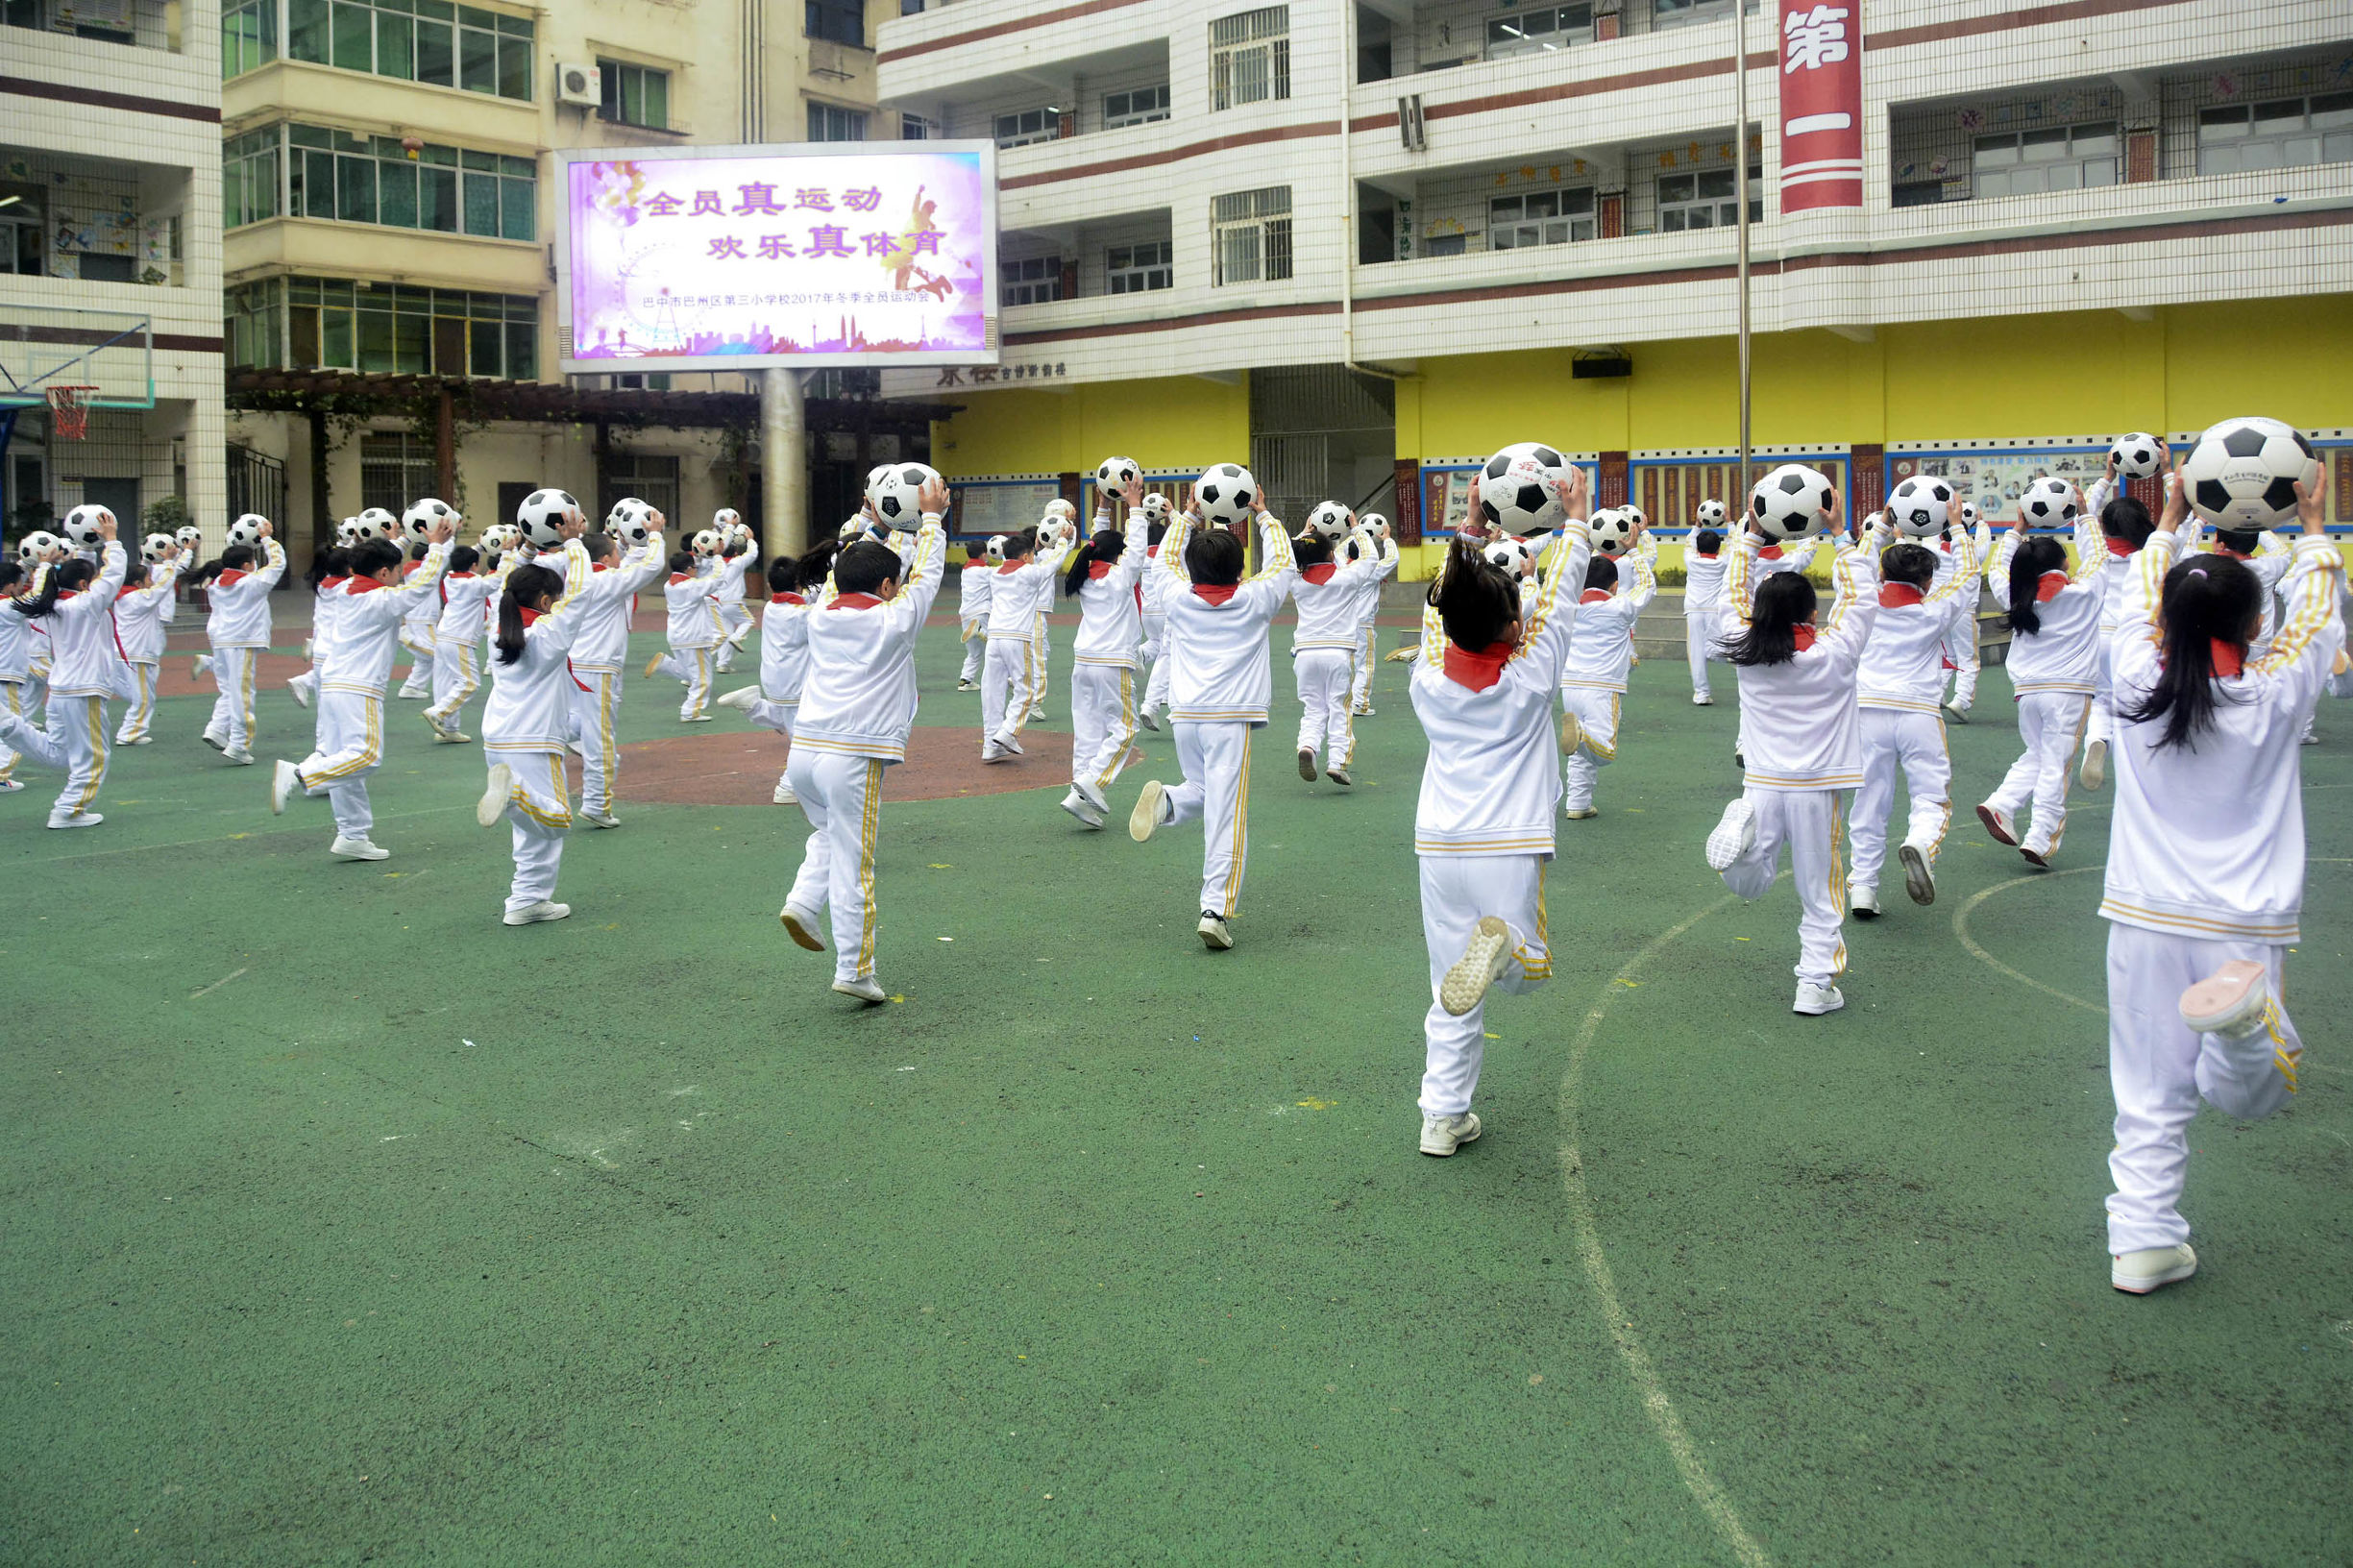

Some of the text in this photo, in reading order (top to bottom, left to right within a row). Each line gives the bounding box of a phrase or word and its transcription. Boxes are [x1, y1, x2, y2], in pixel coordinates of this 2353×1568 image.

[1784, 4, 1851, 136] 第一
[643, 180, 883, 218] 全员真运动
[706, 223, 947, 260] 欢乐真体育
[642, 290, 931, 308] 巴中市巴州区第三小学校2017年冬季全员运动会
